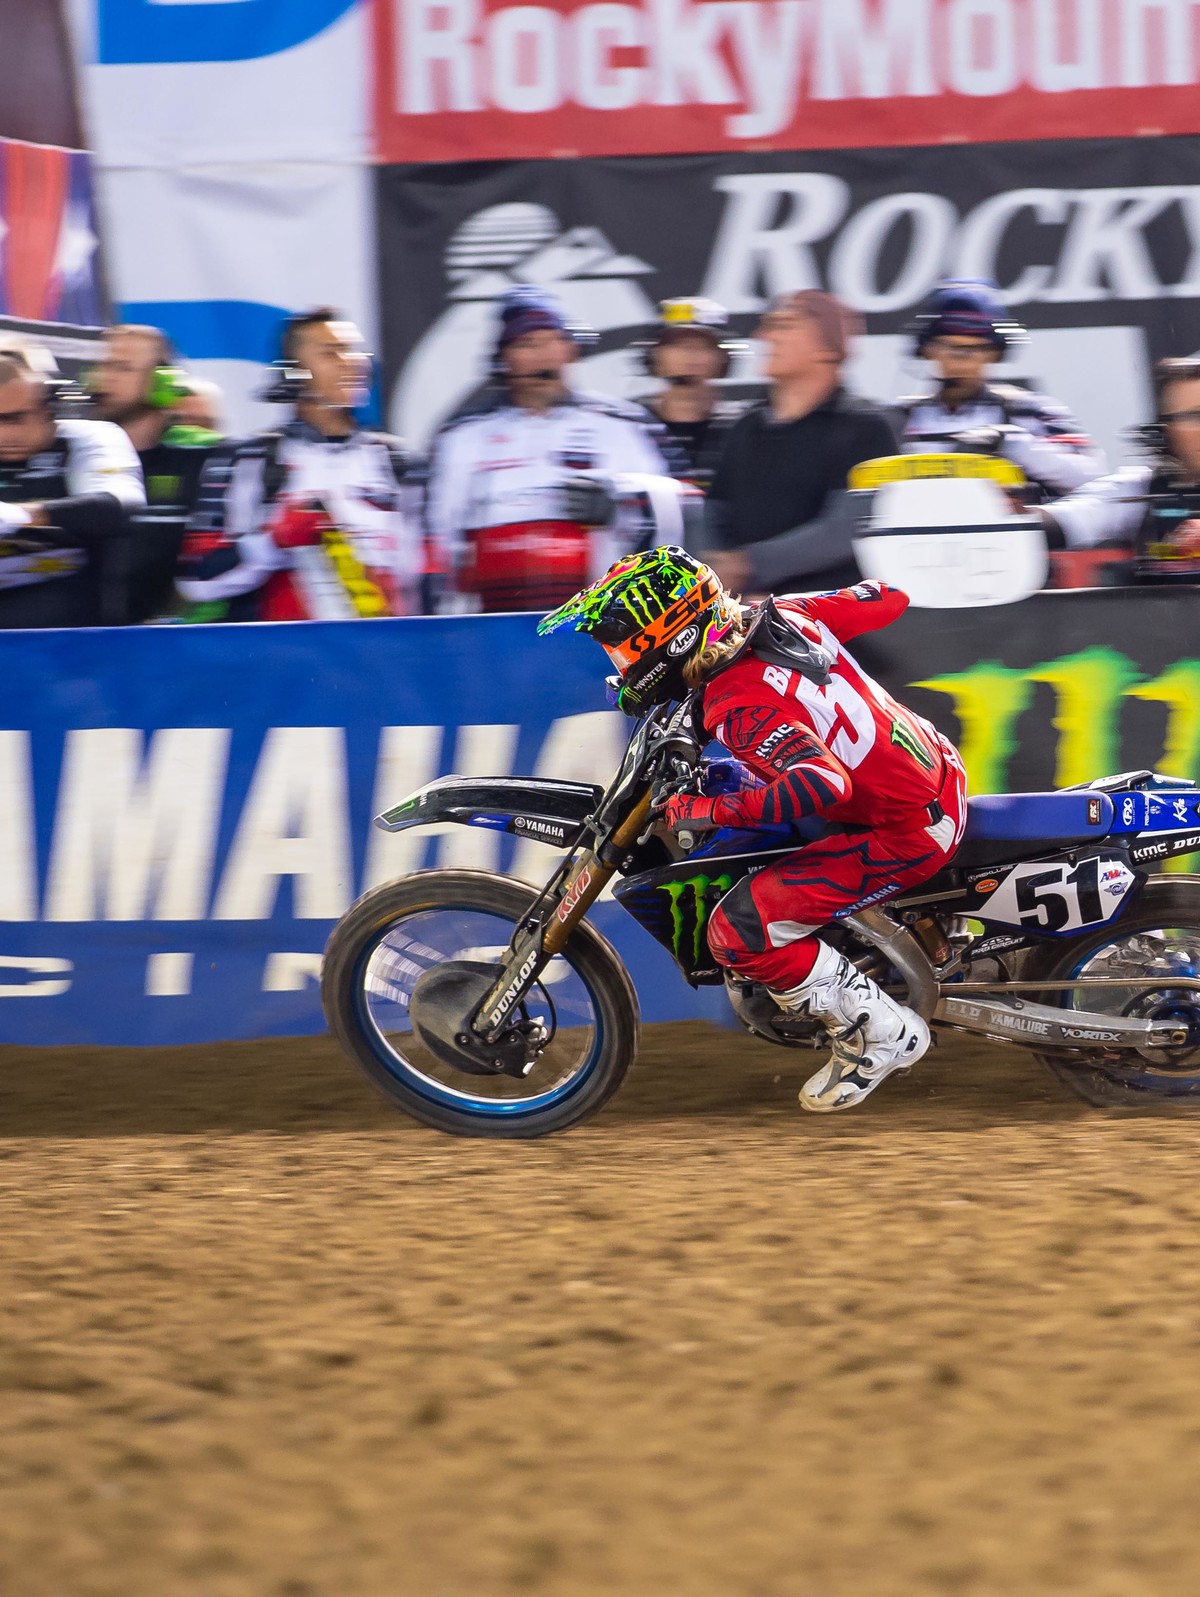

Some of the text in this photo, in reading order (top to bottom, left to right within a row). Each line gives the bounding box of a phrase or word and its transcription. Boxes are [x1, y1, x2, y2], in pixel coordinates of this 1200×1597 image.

[633, 661, 668, 691] MONSTER
[526, 819, 564, 838] YAMAHA
[850, 884, 901, 910] YAMAHA
[1015, 856, 1104, 931] 51
[489, 950, 538, 1027] DUNLOP
[990, 1012, 1053, 1035] YAMALUBE
[1061, 1027, 1123, 1042] VORTEX
